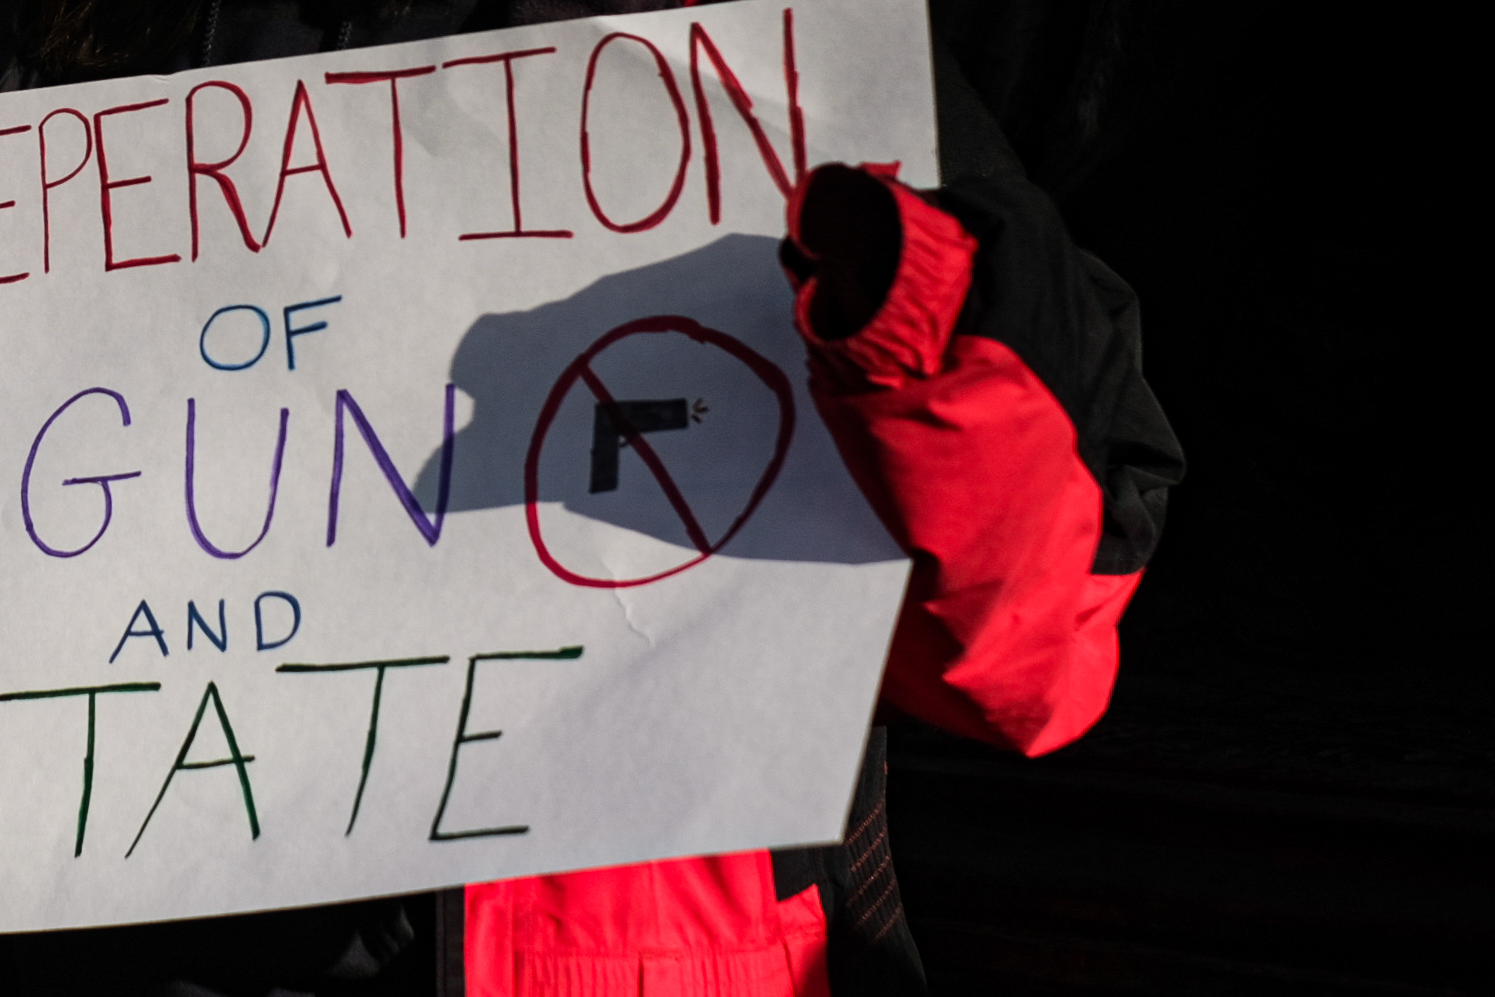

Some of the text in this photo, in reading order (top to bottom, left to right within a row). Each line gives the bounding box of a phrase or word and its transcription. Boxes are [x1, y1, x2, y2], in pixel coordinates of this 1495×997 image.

[198, 294, 344, 372] OF
[19, 382, 457, 560] GUN
[108, 590, 303, 664] AND
